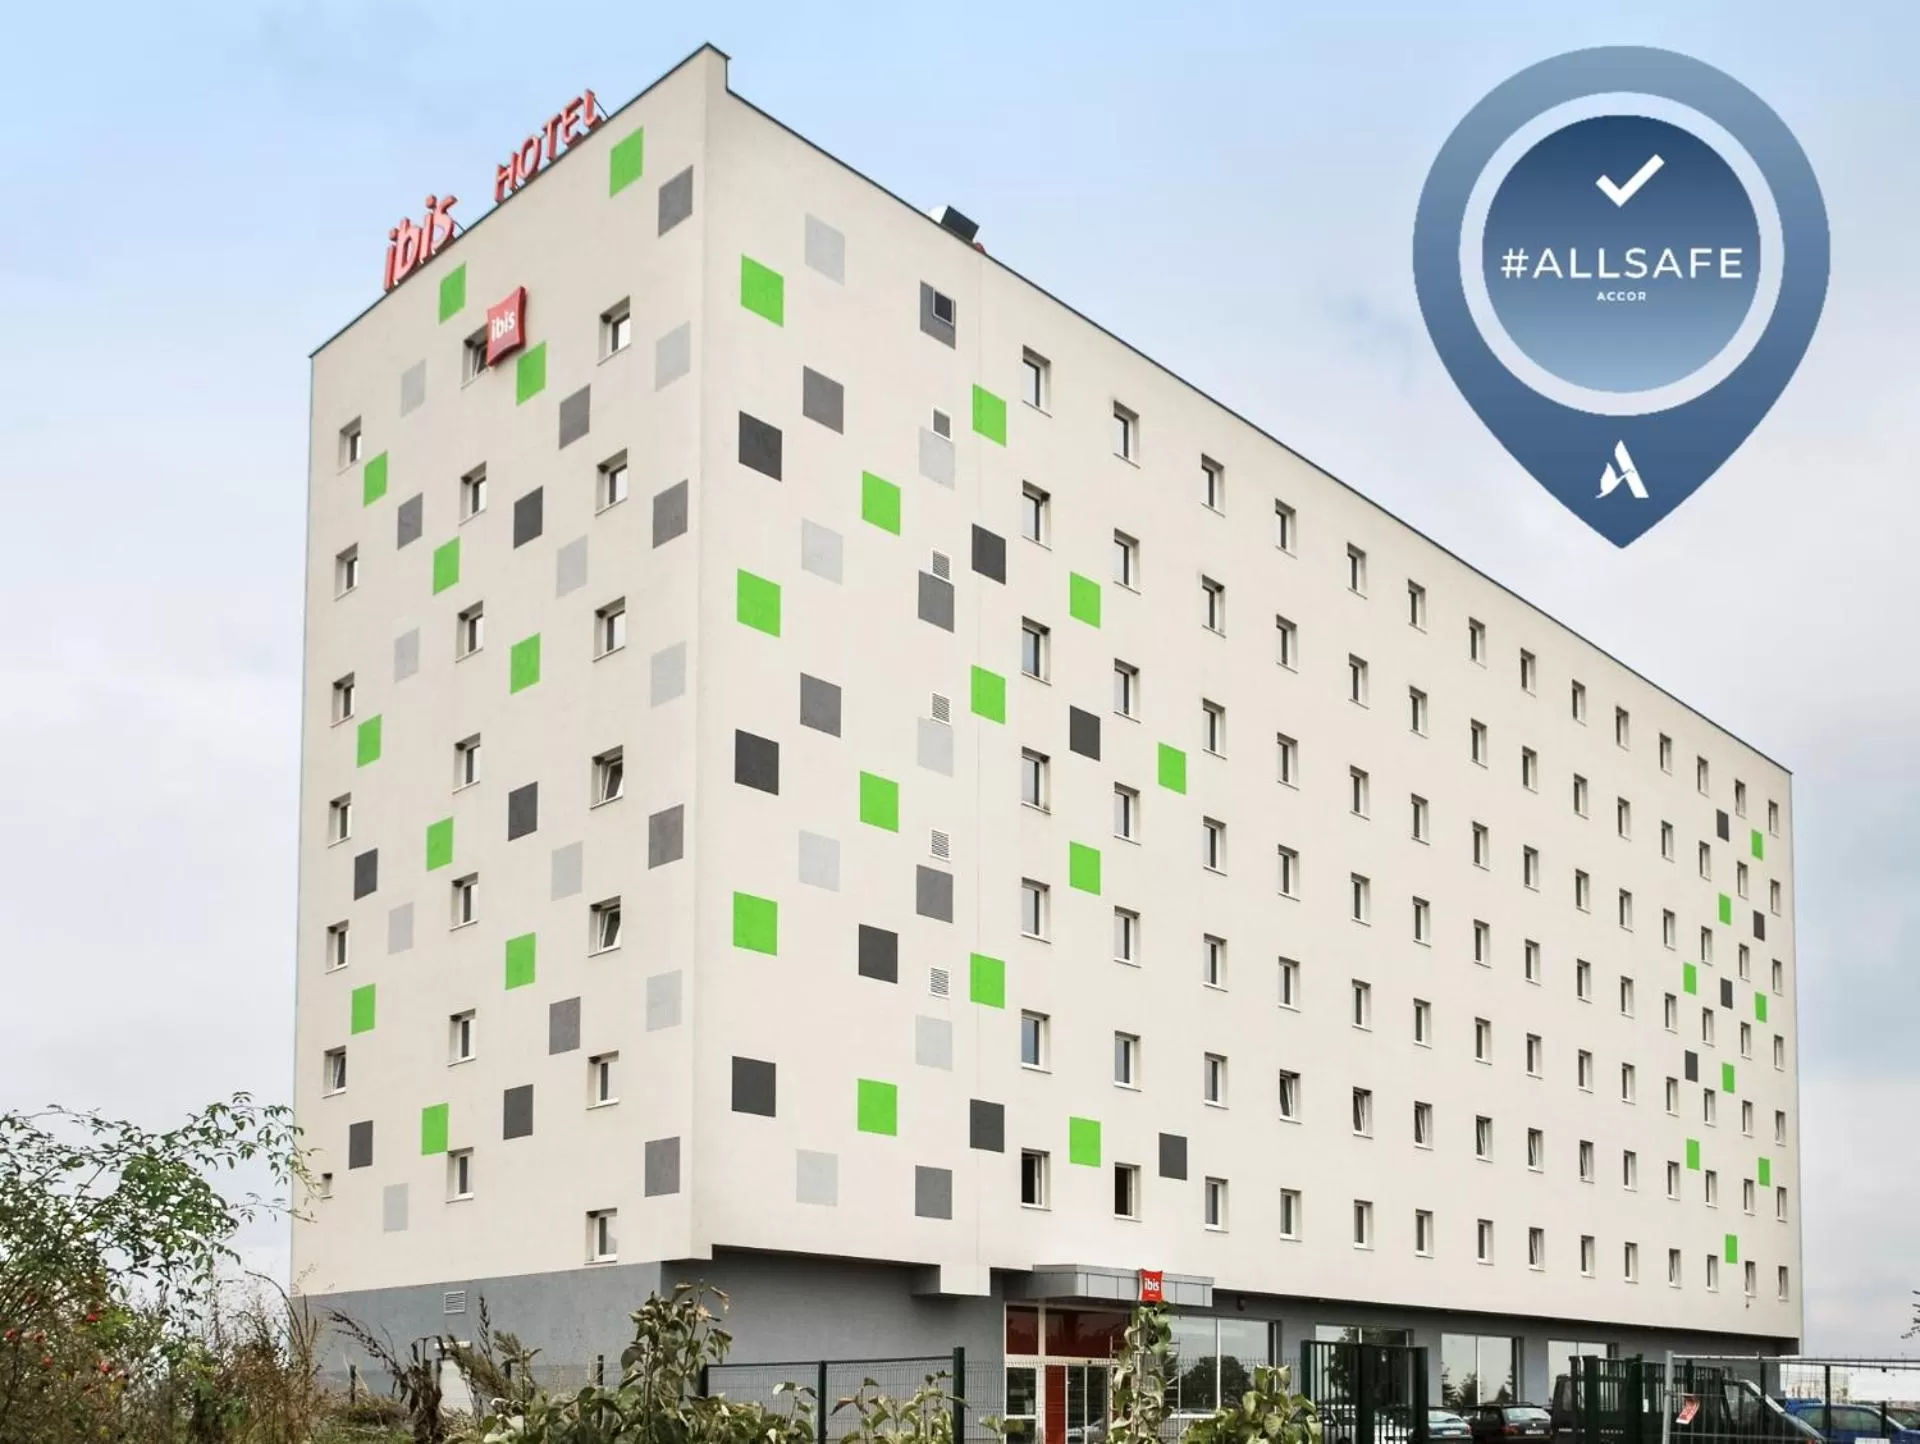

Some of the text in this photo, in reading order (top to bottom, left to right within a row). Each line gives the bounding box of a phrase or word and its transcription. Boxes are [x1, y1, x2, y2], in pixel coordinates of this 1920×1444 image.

[384, 89, 603, 292] ibis HOTEL
[491, 311, 515, 342] ibis
[1144, 1277, 1160, 1291] ibis
